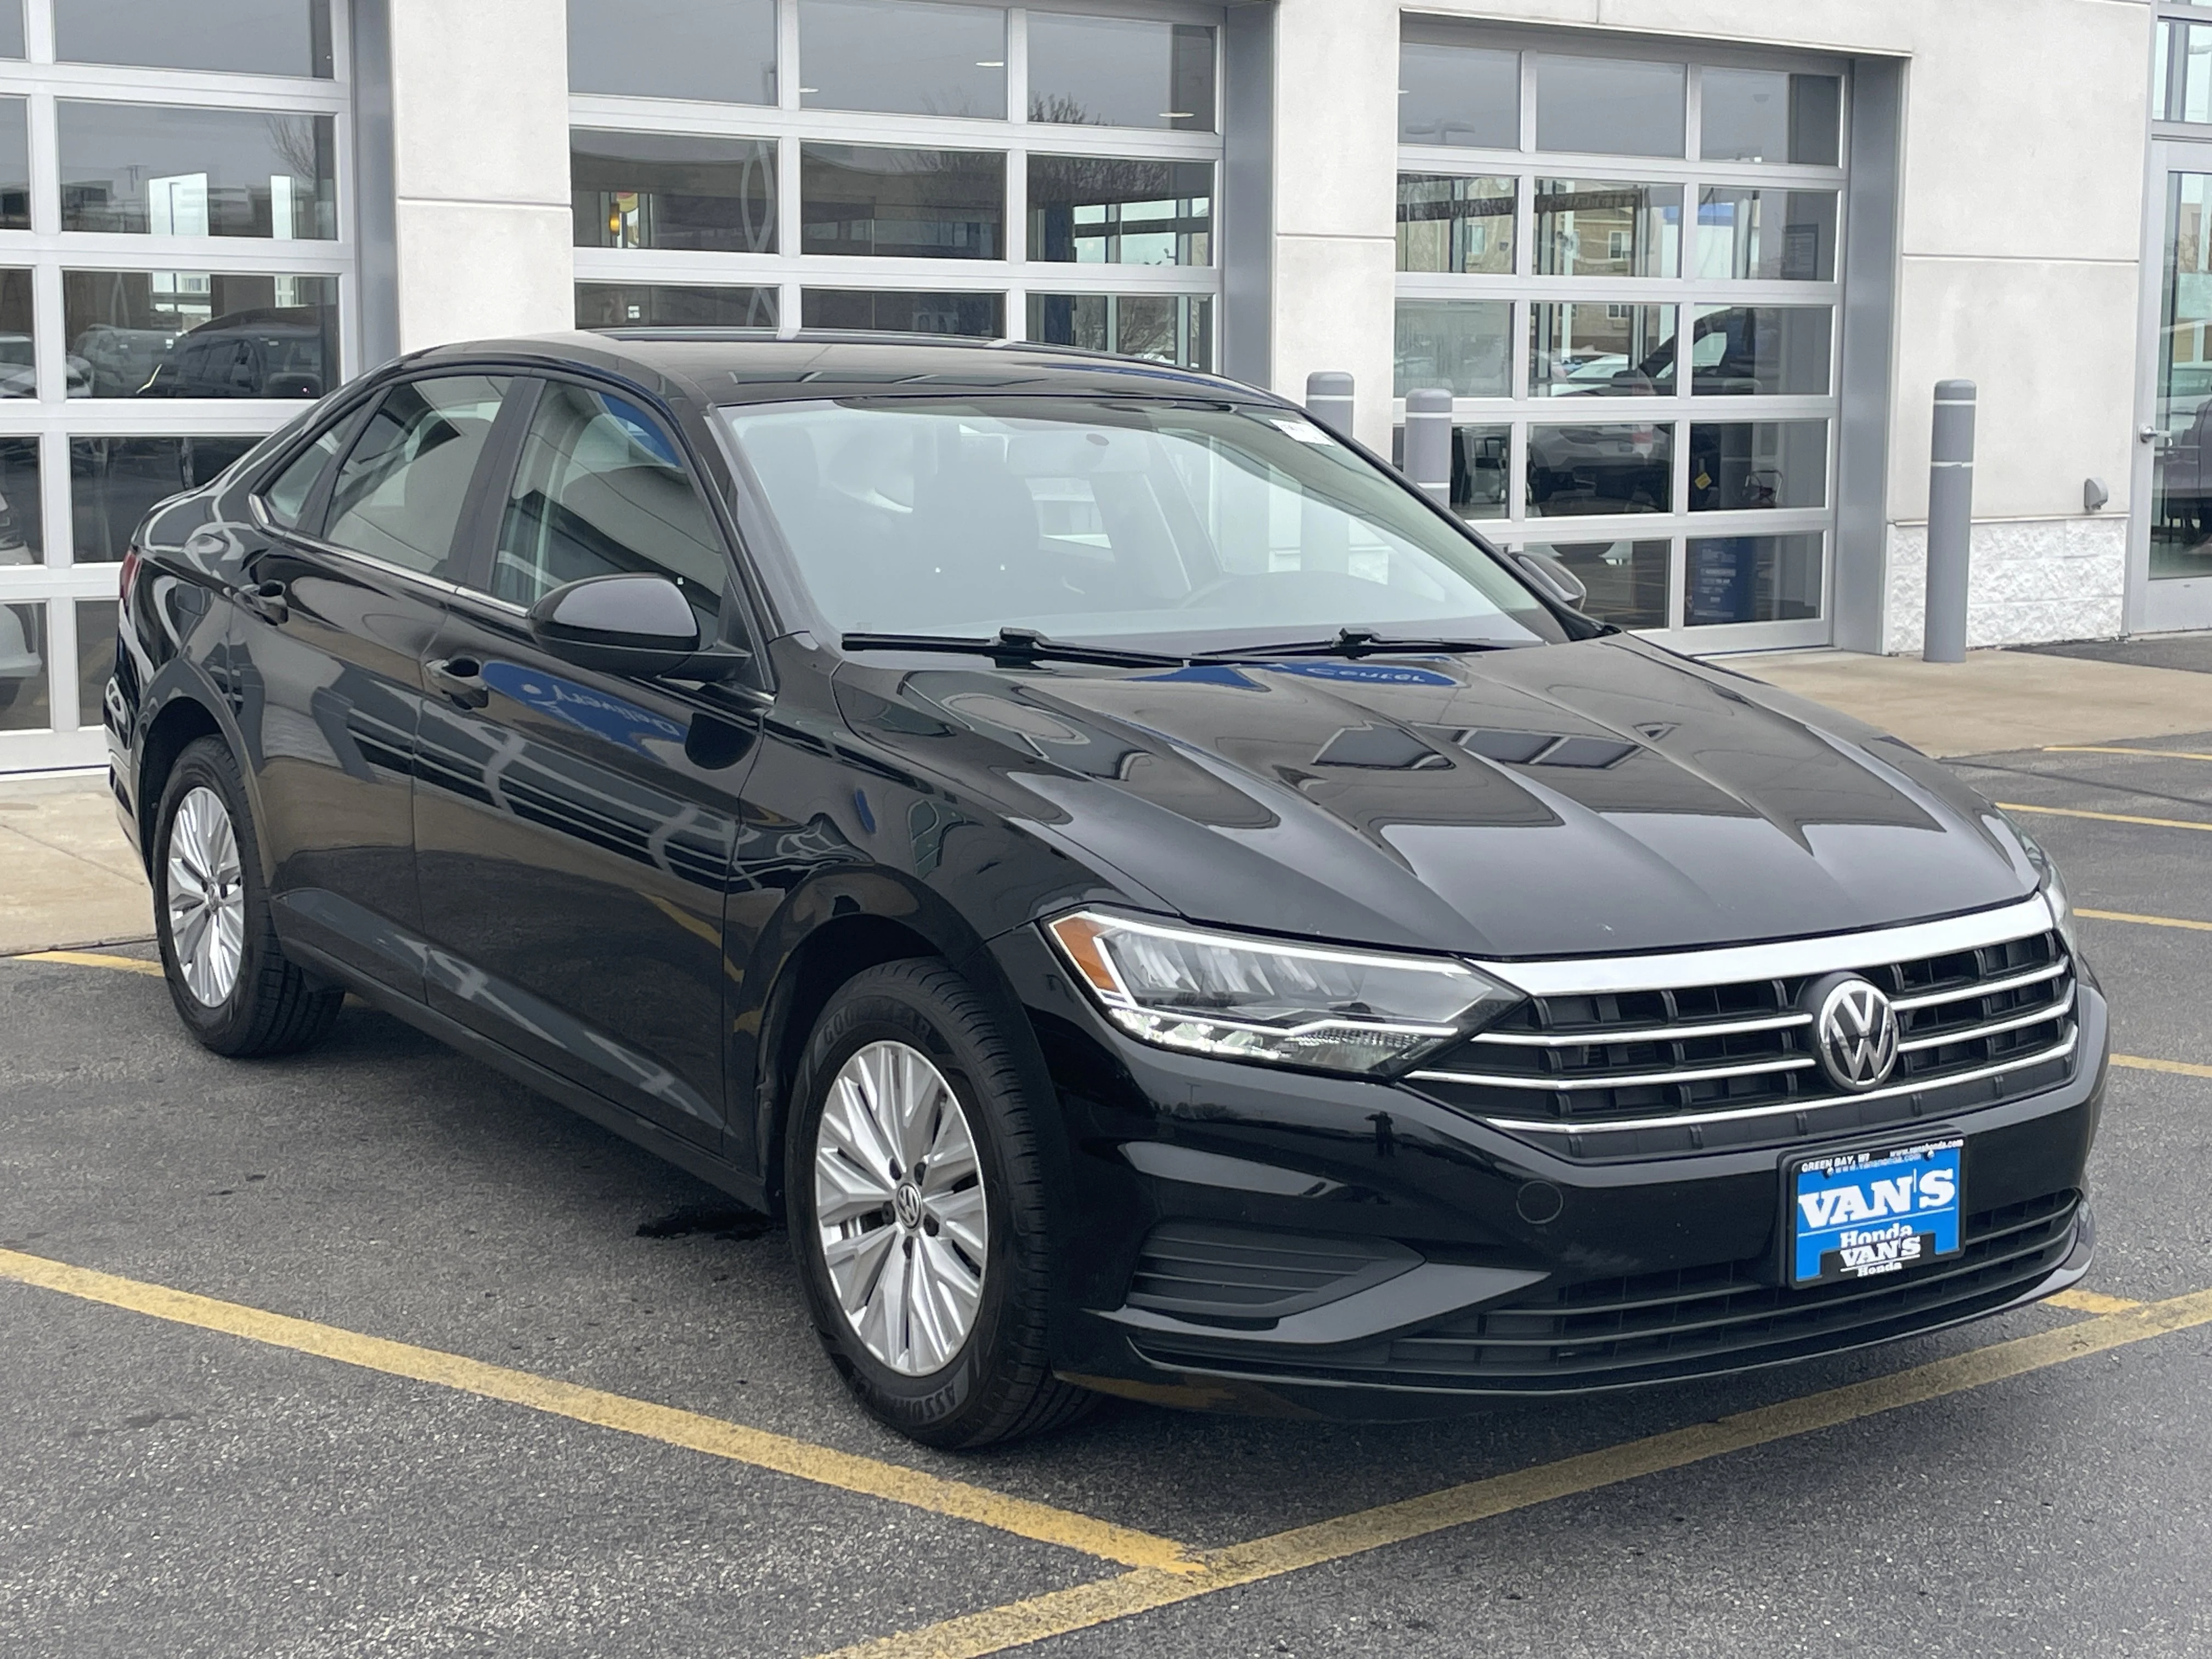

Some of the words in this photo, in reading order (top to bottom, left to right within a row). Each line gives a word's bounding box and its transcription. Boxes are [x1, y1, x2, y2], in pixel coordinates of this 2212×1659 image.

[1802, 1158, 1832, 1172] GREEN
[1798, 1169, 1955, 1229] VAN'S
[1840, 1223, 1913, 1249] Honda
[1840, 1236, 1920, 1267] VAN'S
[1857, 1262, 1902, 1277] Honda
